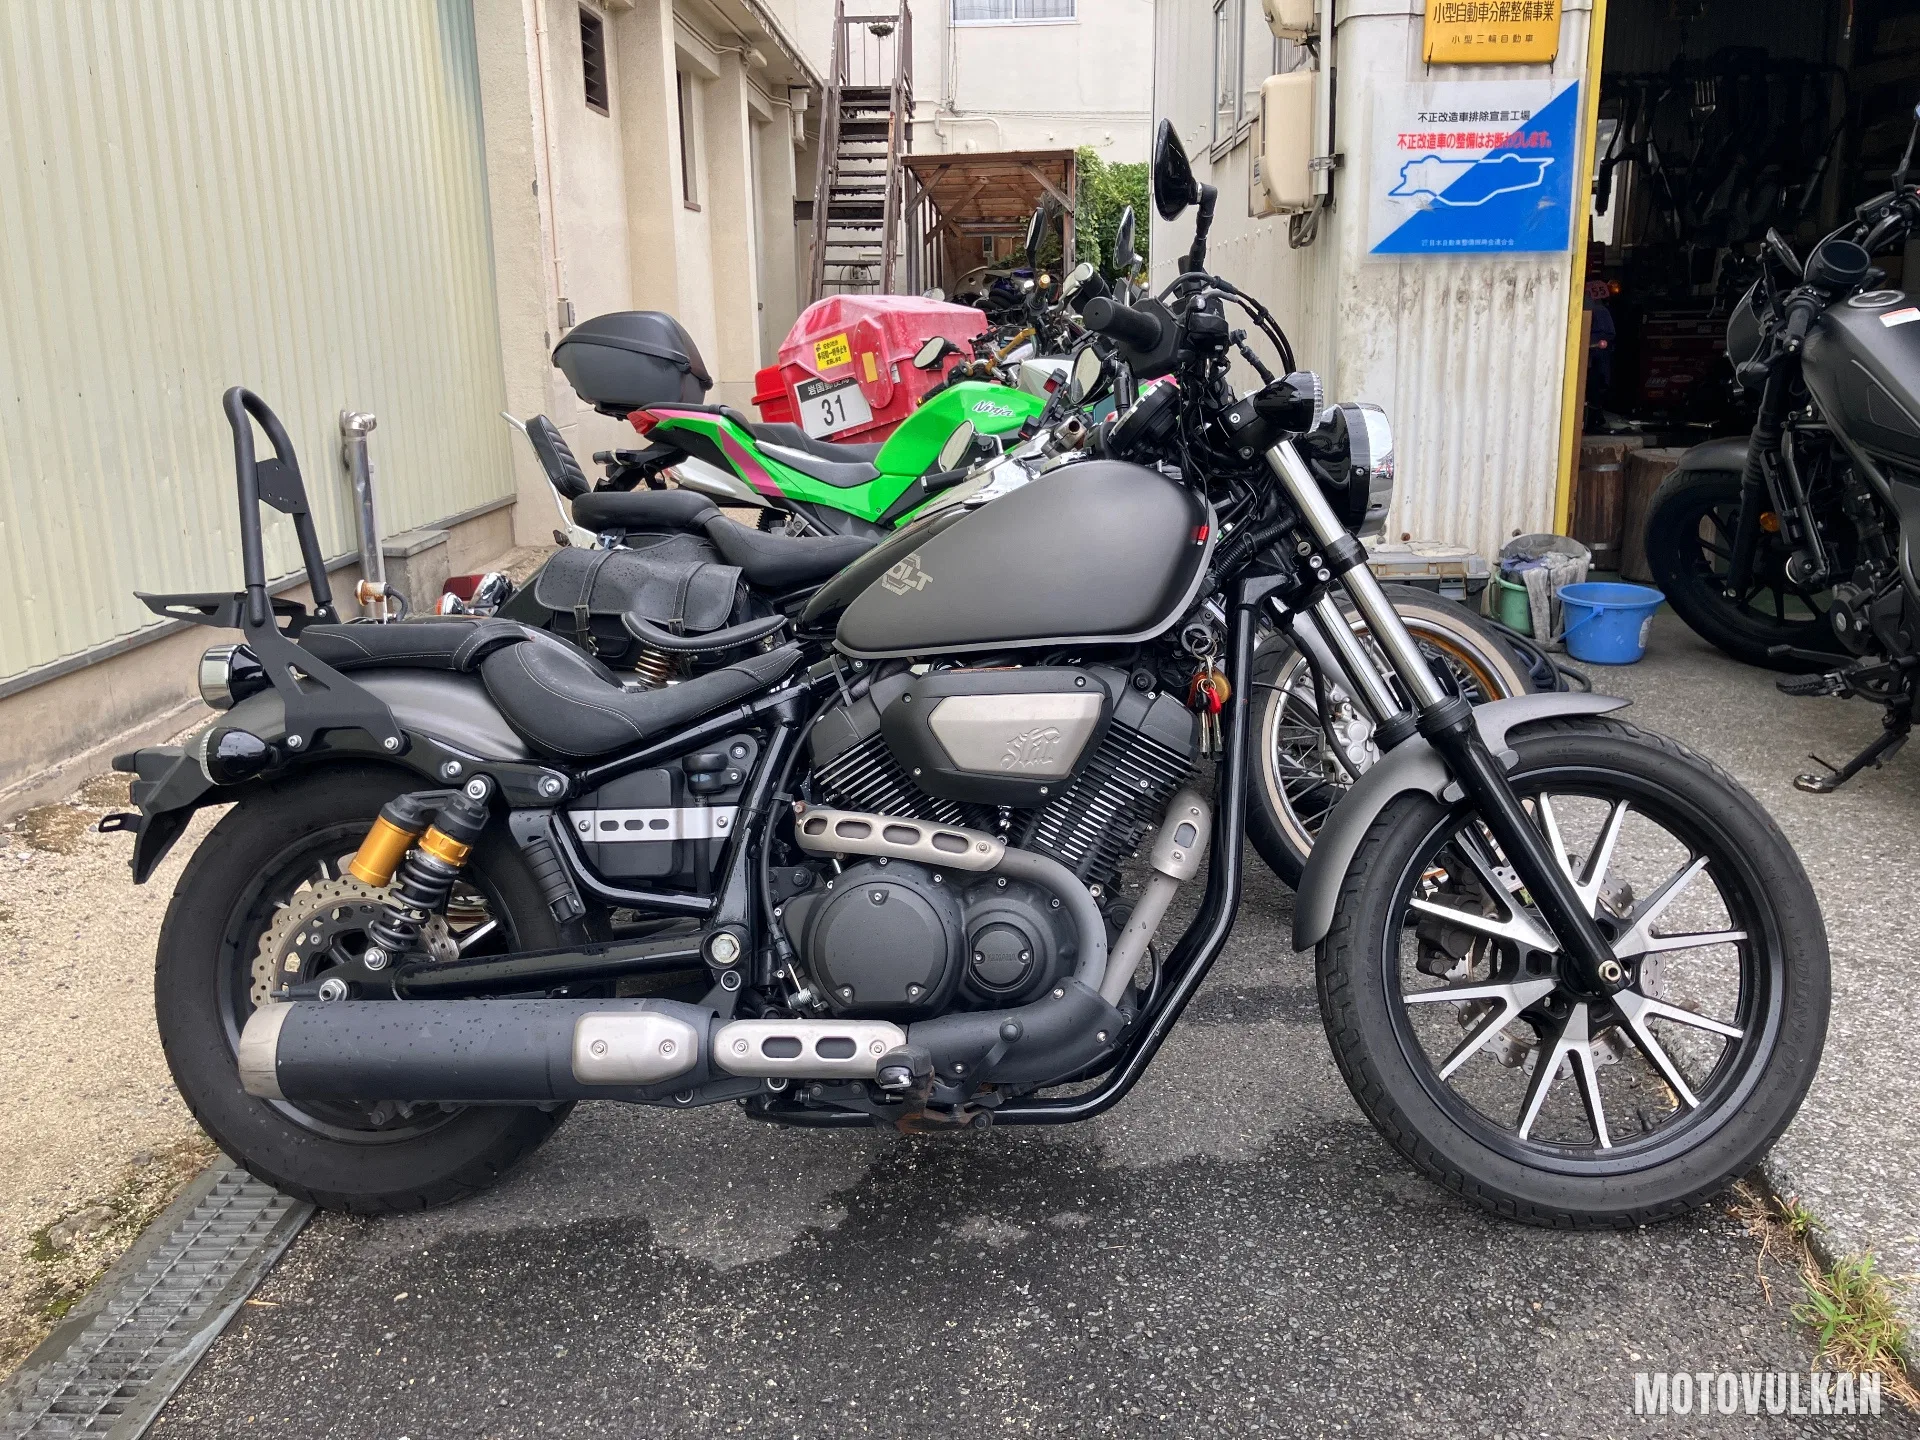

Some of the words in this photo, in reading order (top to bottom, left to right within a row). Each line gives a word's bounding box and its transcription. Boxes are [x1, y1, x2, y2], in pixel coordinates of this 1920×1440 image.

[1433, 1, 1555, 23] 小型自動車分解整備事業
[1451, 34, 1534, 45] 小型二輪自動車
[1417, 110, 1531, 123] 不正改造車排除宣言工場
[821, 394, 846, 427] 31
[972, 400, 1014, 417] Ninja
